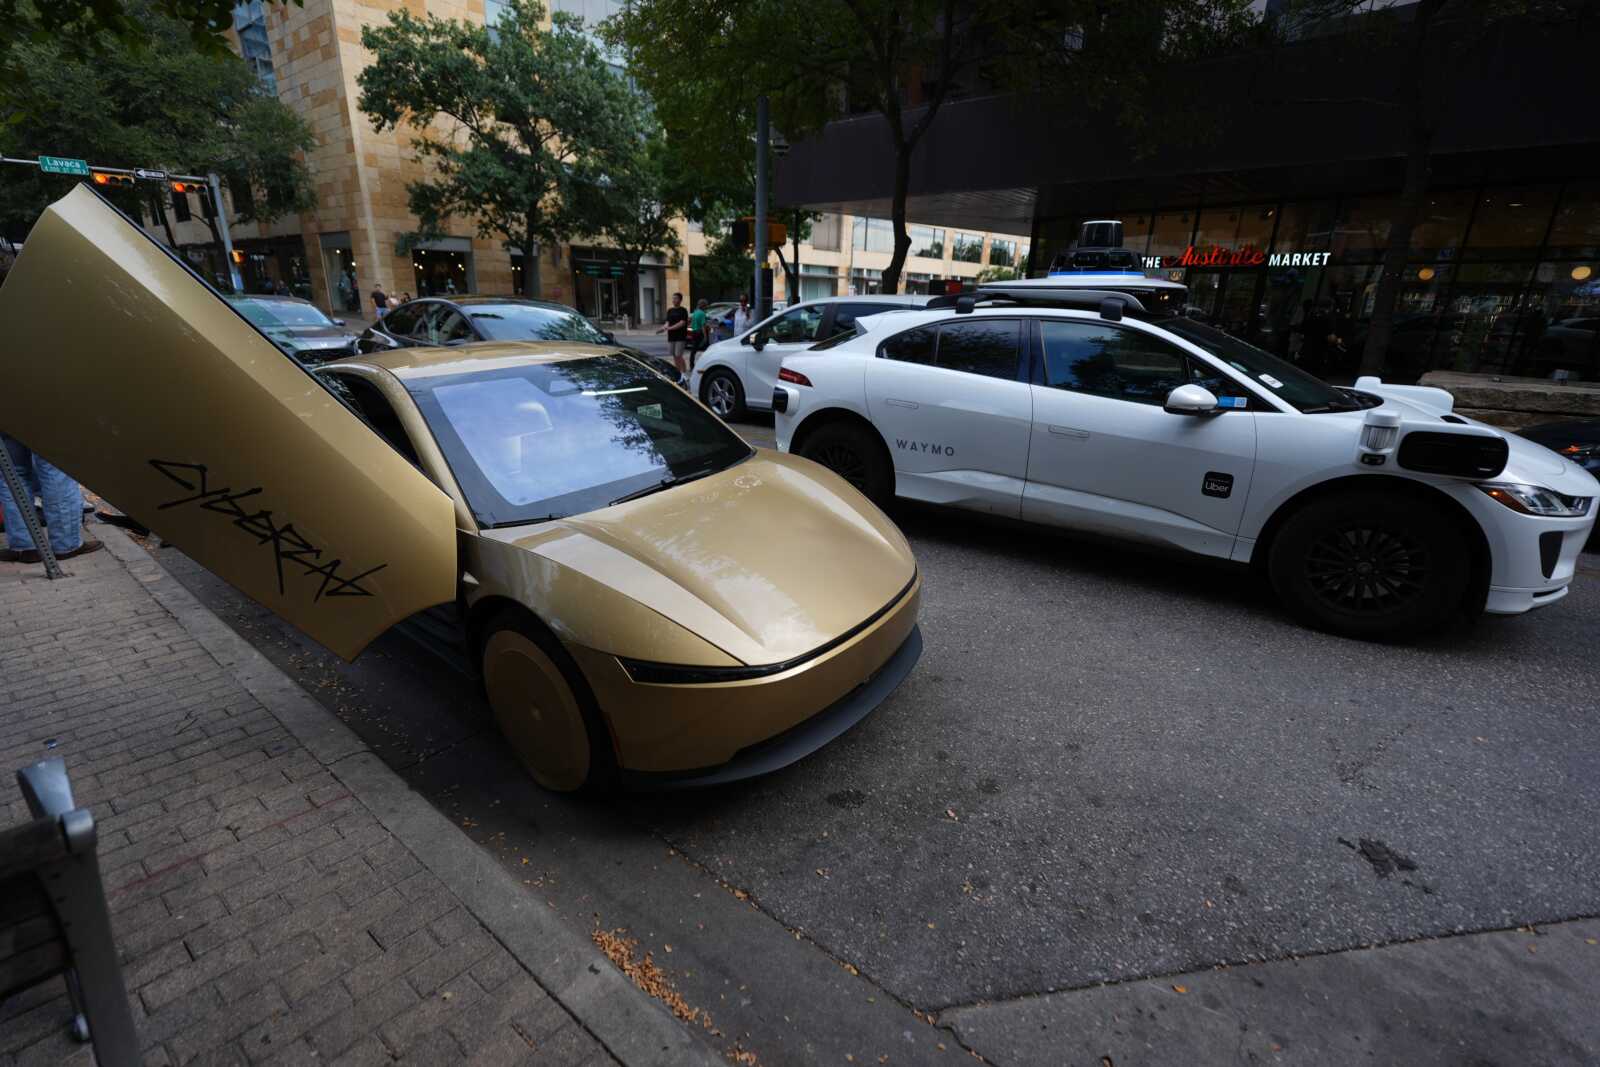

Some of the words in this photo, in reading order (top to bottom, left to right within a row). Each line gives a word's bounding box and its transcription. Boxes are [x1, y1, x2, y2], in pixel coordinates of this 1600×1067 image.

[46, 157, 80, 168] Lavaca
[1141, 256, 1161, 268] THE
[1268, 252, 1331, 267] MARKET
[896, 439, 954, 456] WAYMO
[1205, 480, 1230, 492] Uber
